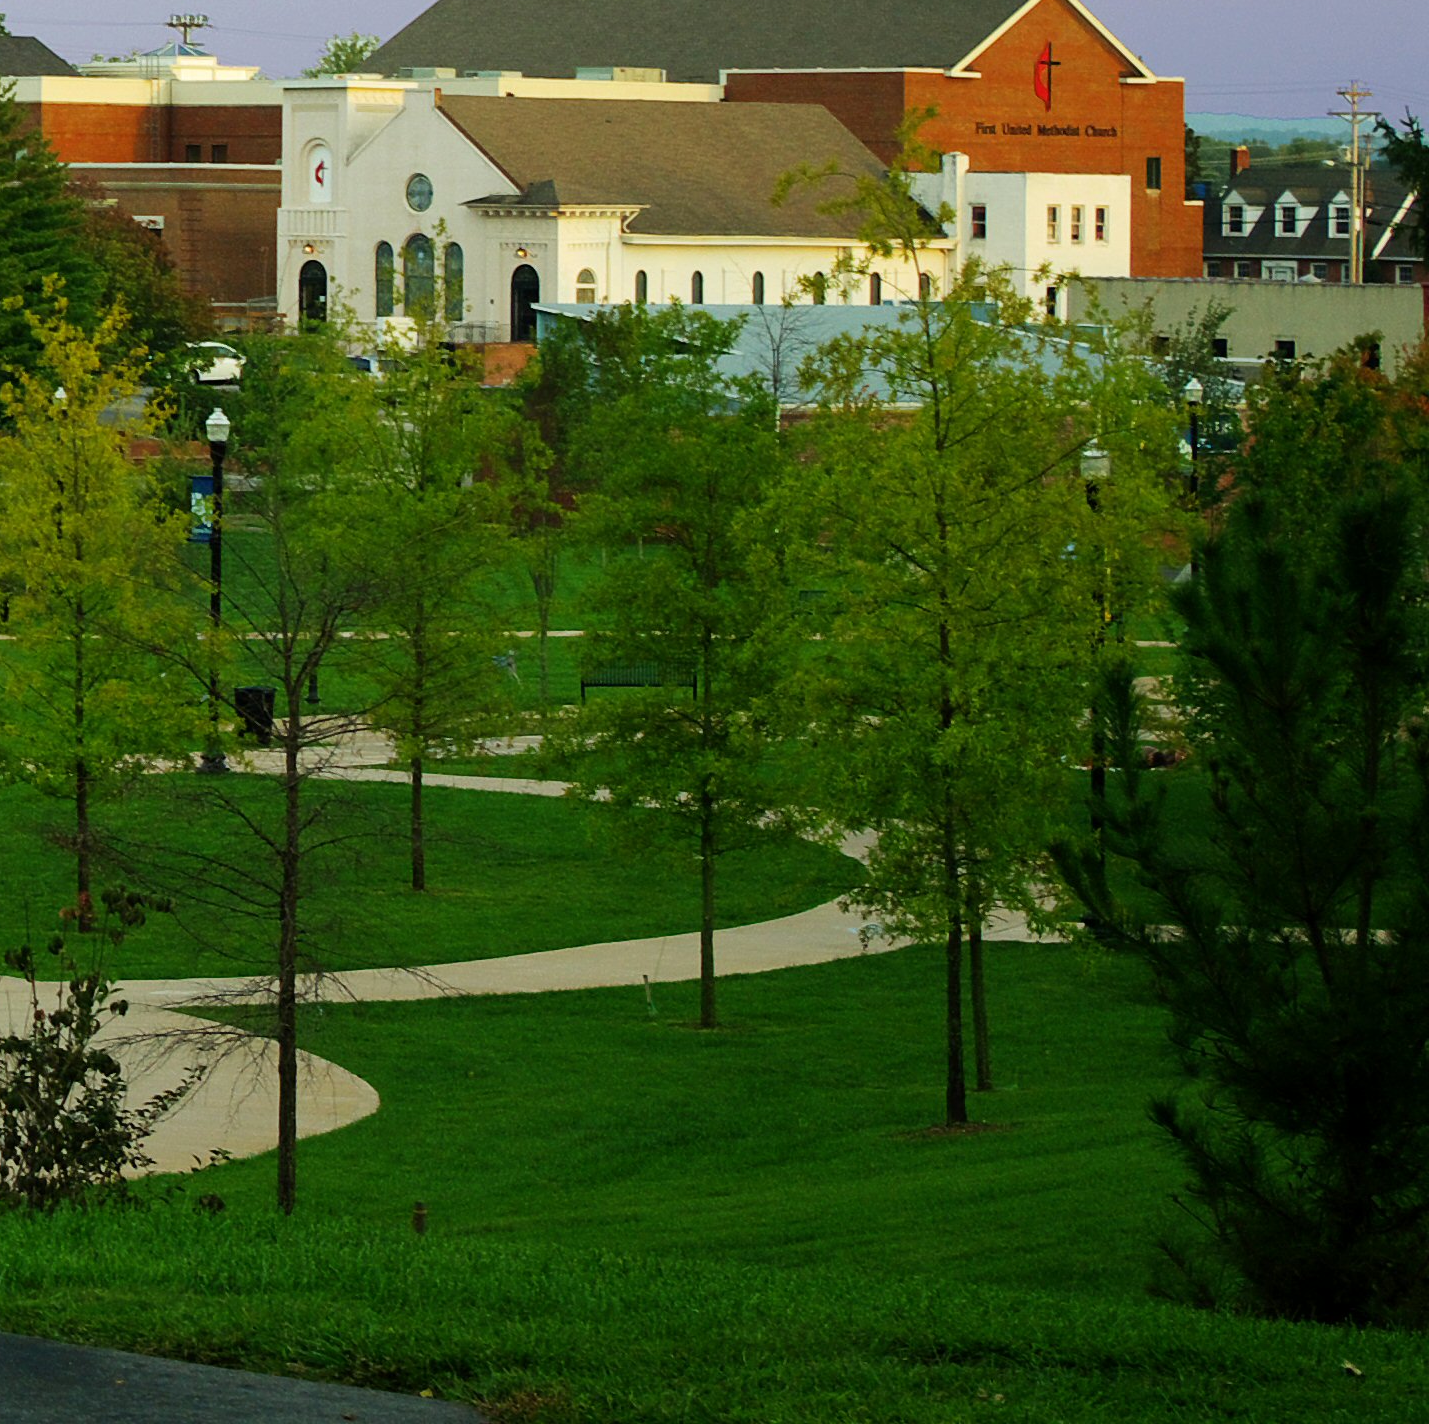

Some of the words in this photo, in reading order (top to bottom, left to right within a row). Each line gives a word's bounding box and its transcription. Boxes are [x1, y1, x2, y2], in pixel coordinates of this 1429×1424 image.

[975, 122, 997, 135] First
[1002, 123, 1032, 136] United
[1037, 124, 1080, 137] Methodist
[1085, 125, 1118, 137] Church
